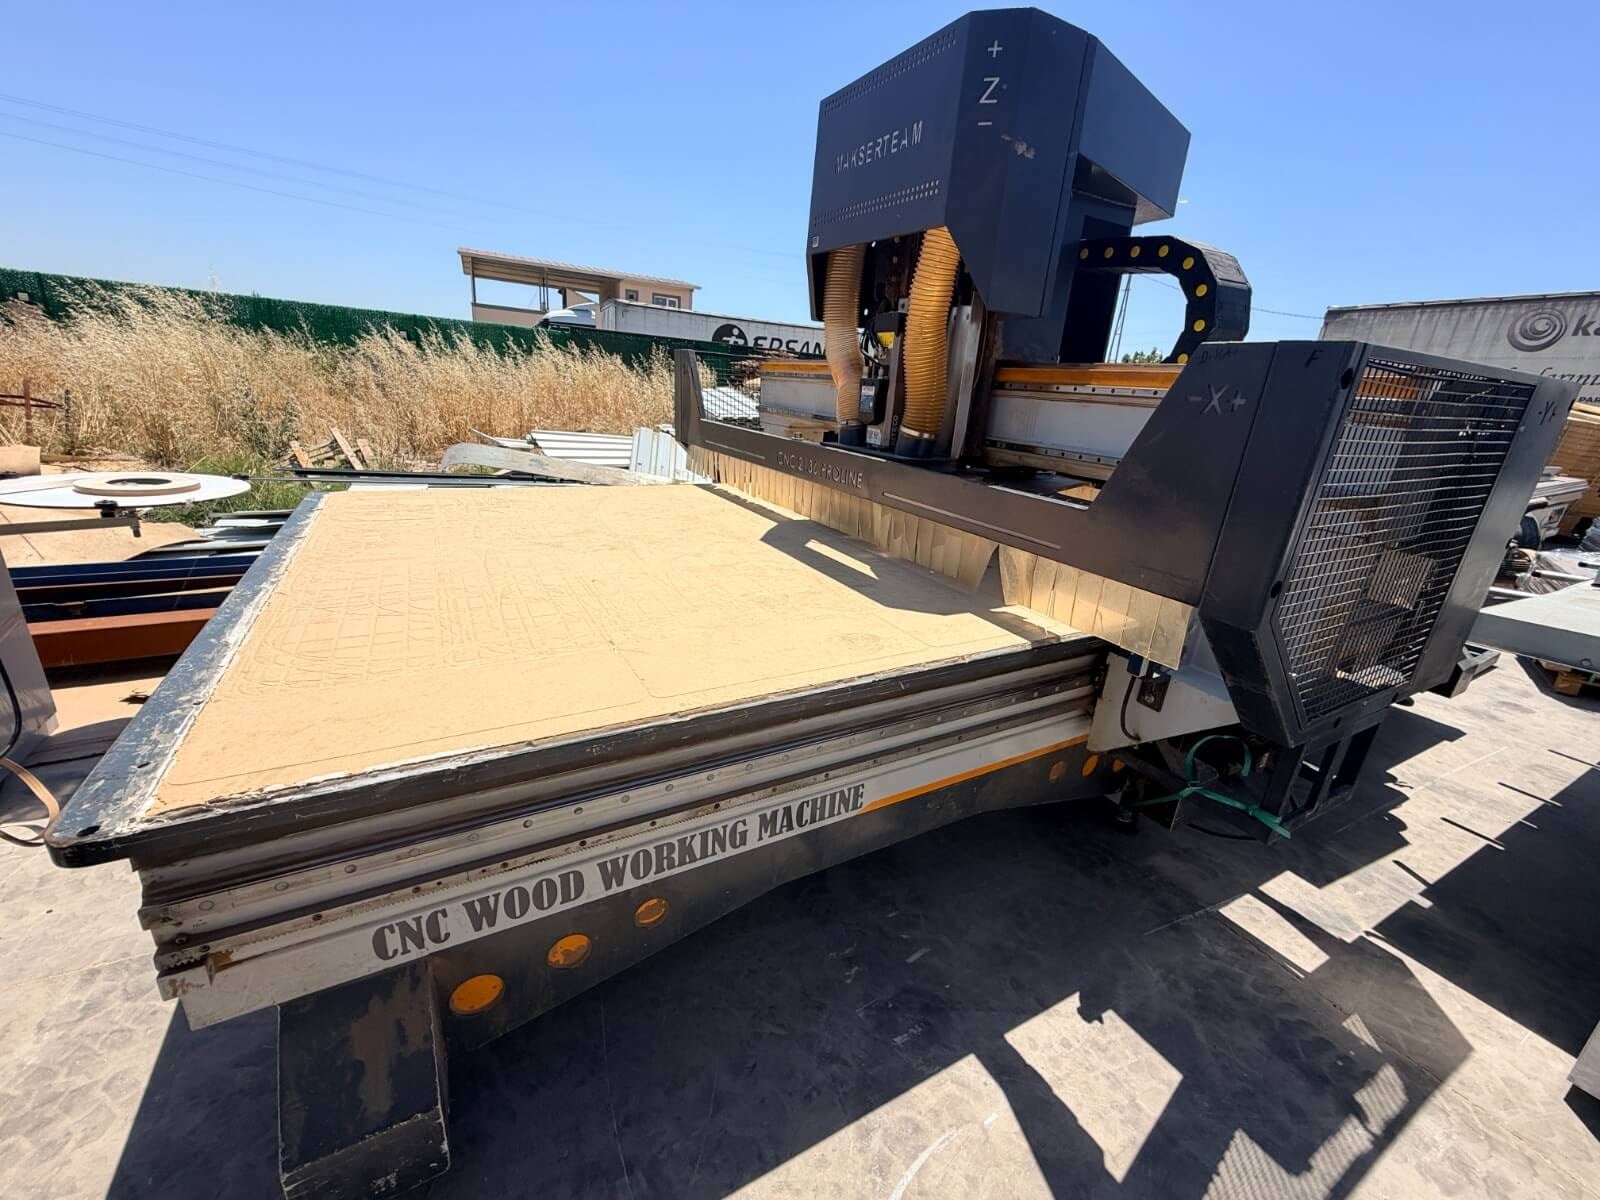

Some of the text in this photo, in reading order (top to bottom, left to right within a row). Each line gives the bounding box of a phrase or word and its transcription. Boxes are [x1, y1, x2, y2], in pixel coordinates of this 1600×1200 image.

[979, 76, 1000, 103] Z
[835, 119, 923, 174] MAKSERTEAM
[777, 451, 796, 469] CNC
[820, 462, 863, 489] PROLINE
[371, 783, 866, 962] CNC WOOD WORKING MACHINE
